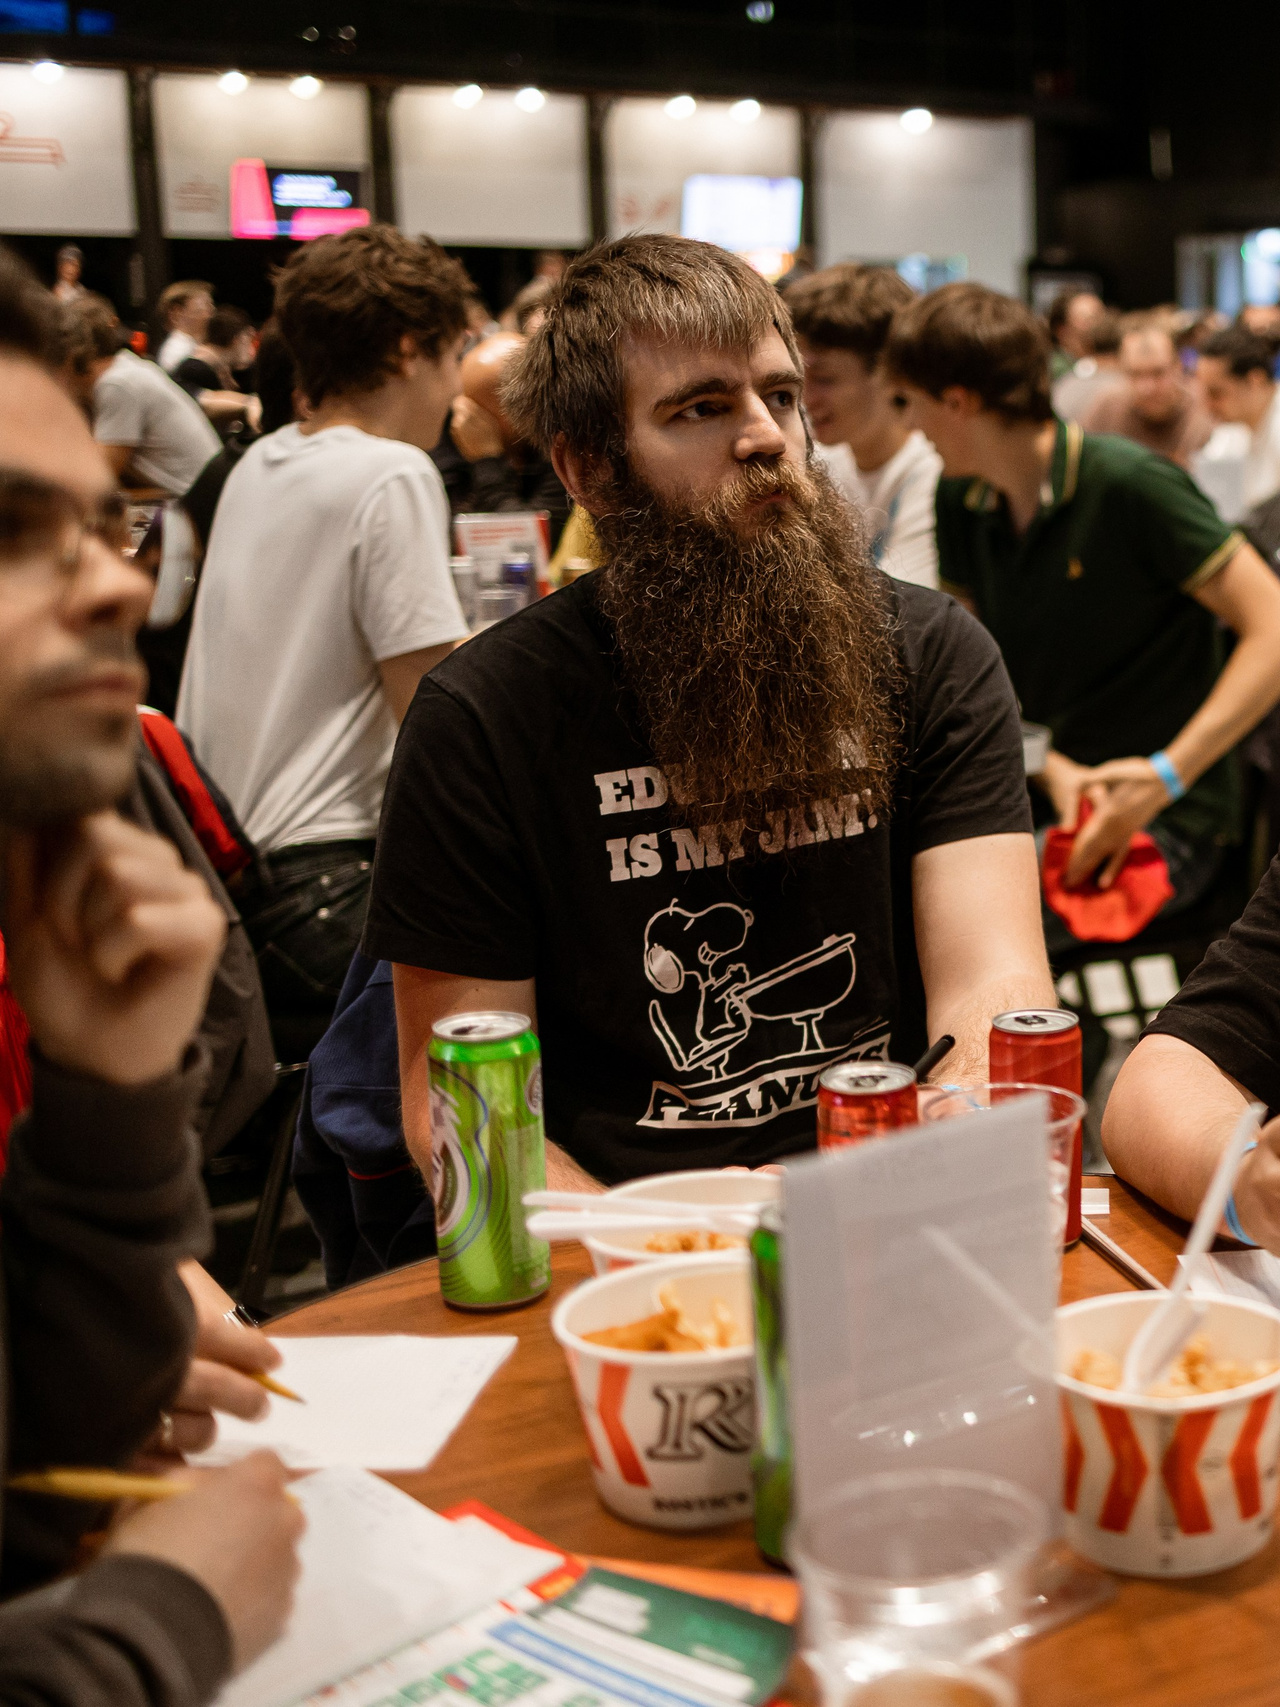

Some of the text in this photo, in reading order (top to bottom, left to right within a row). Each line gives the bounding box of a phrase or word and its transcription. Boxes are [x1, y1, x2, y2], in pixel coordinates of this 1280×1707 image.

[605, 788, 878, 882] IS MY JAM!
